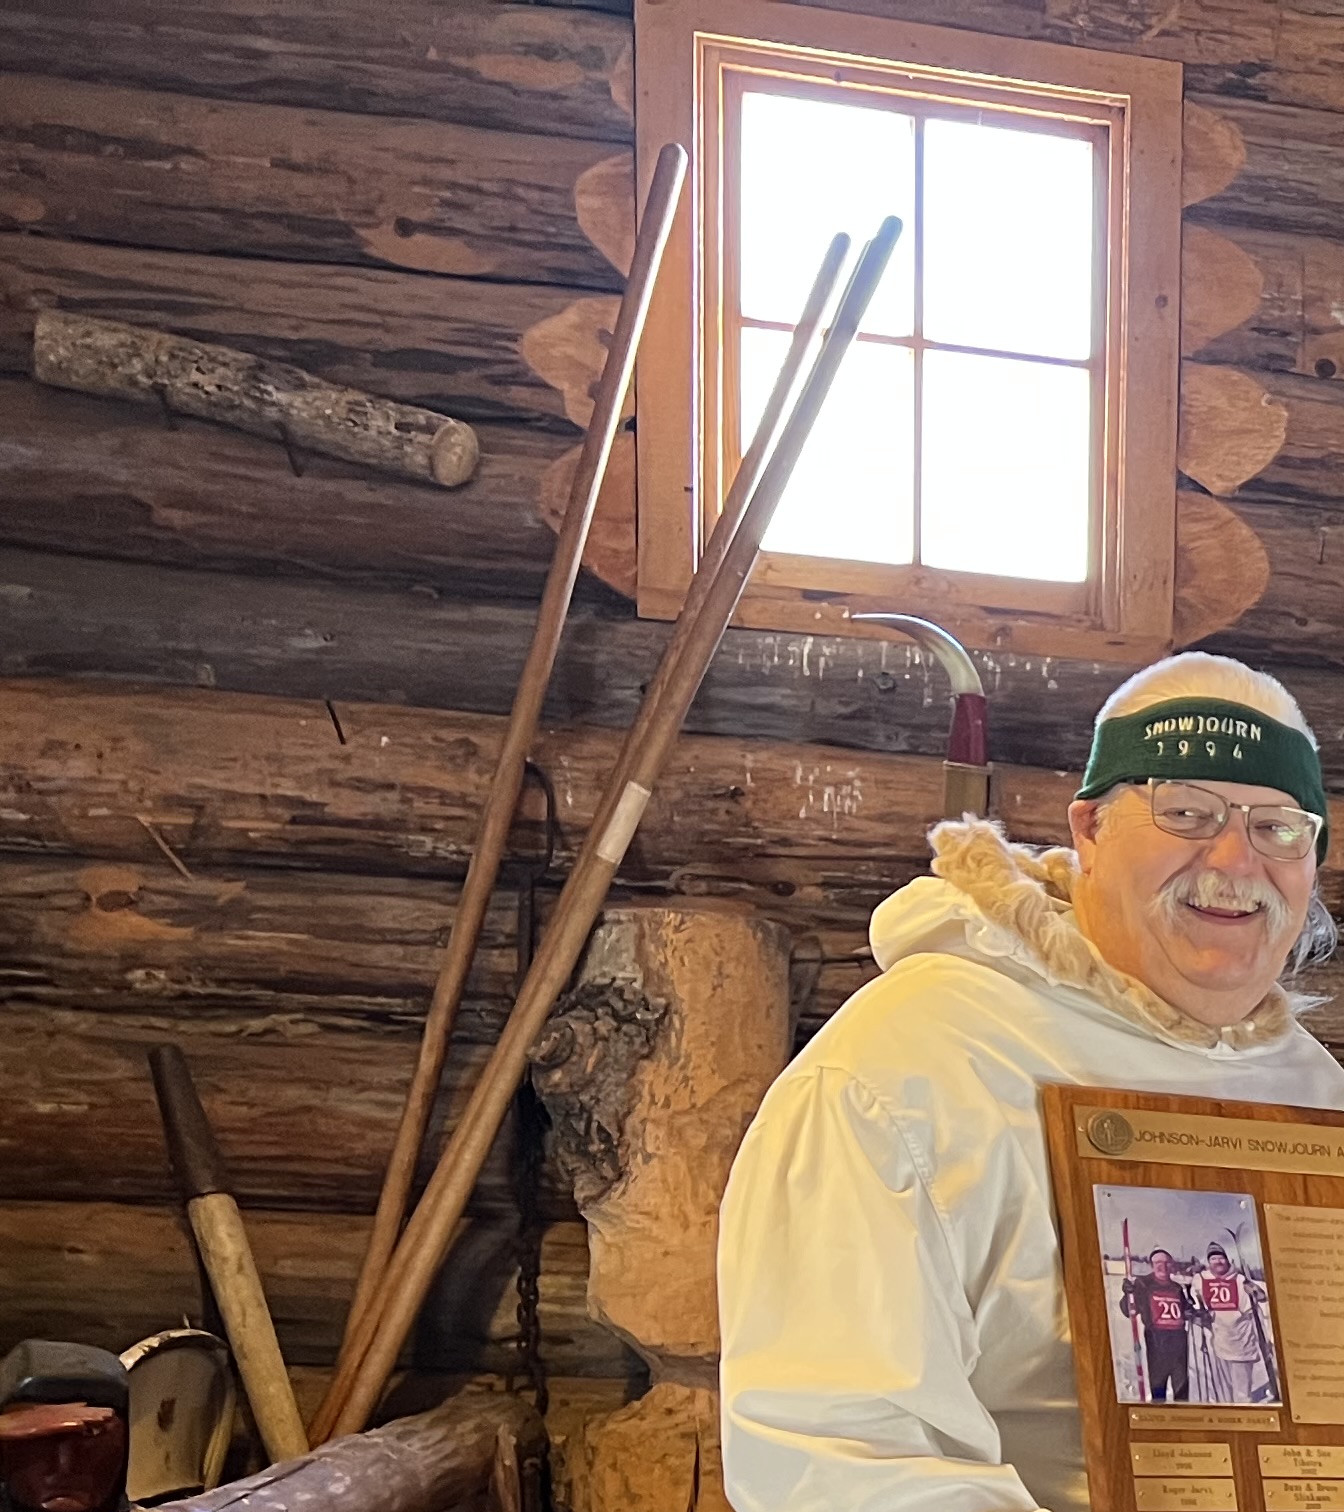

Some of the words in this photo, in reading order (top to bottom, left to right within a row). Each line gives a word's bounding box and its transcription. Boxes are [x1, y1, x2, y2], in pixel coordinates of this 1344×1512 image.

[1144, 715, 1262, 742] SNOWJOURN
[1134, 1129, 1242, 1151] JOHNSON-JARVI
[1248, 1139, 1331, 1158] SNOWJOURN
[1209, 1287, 1231, 1303] 20
[1158, 1302, 1181, 1319] 20
